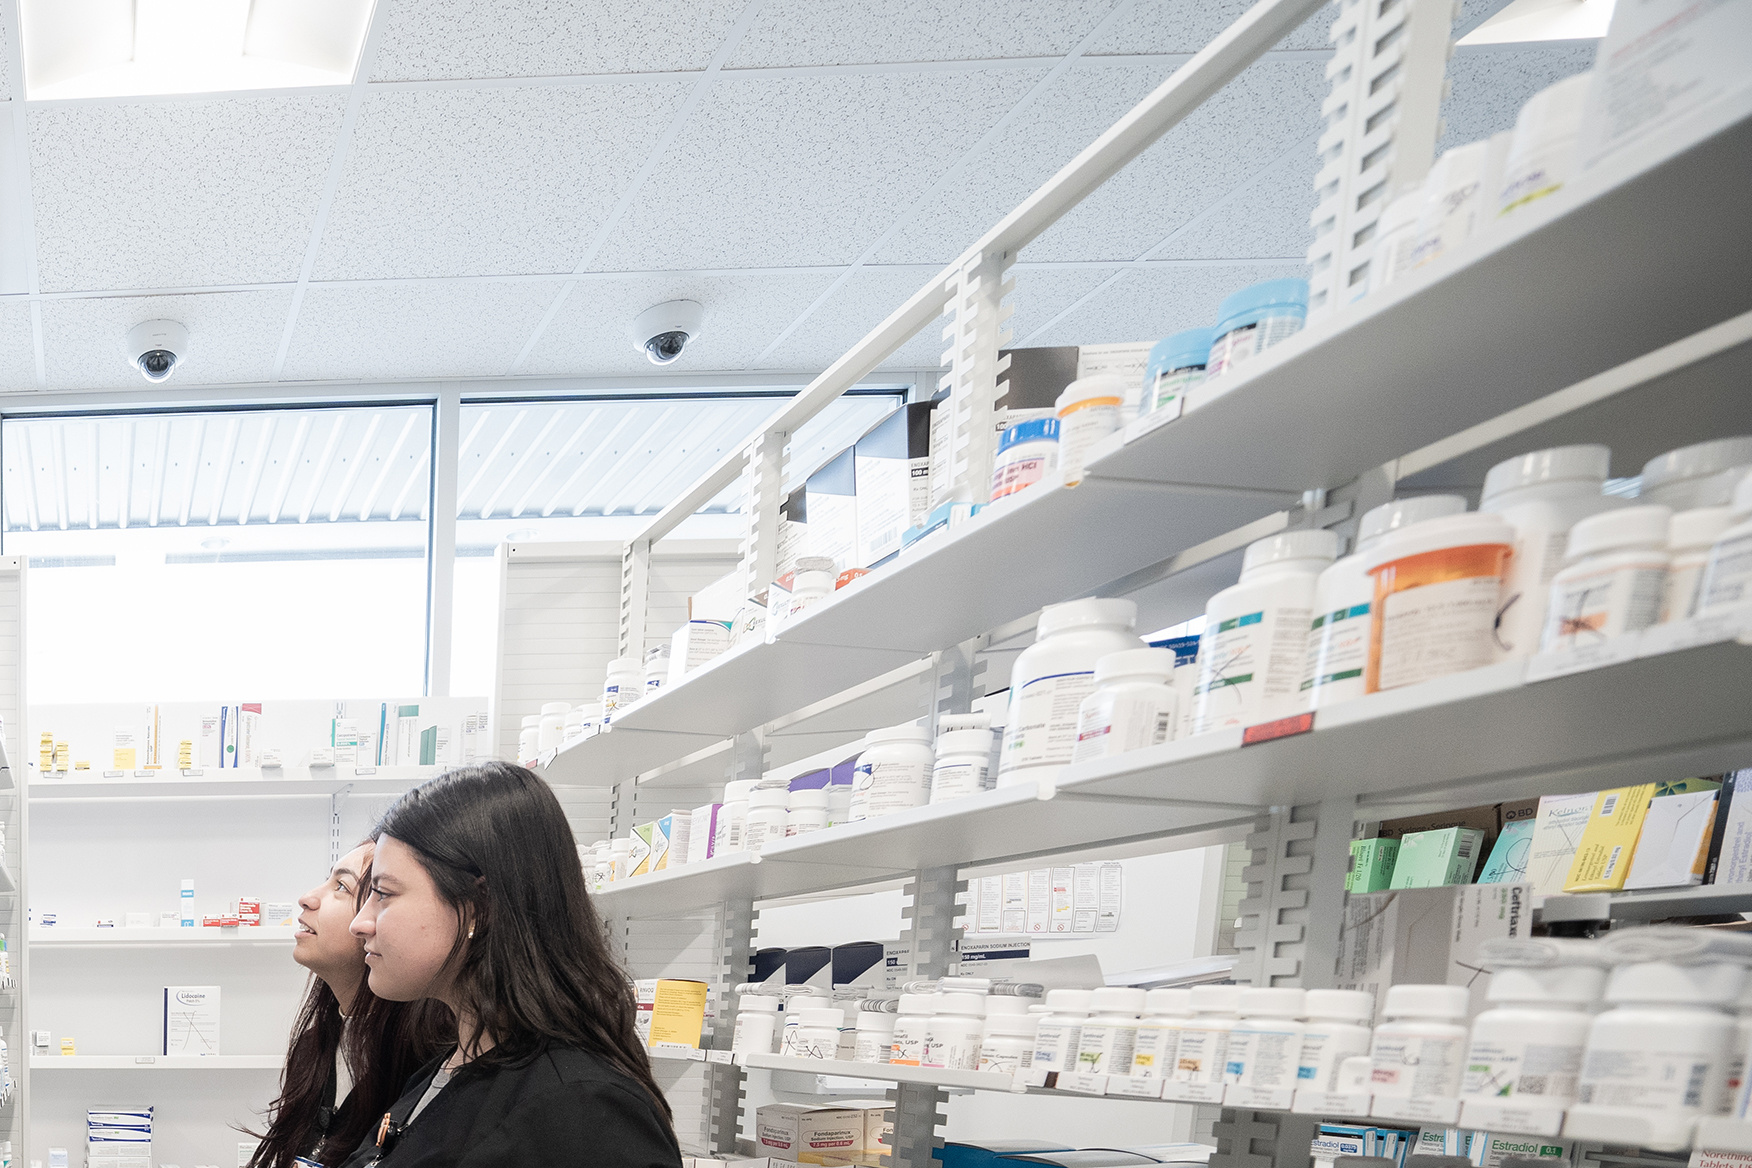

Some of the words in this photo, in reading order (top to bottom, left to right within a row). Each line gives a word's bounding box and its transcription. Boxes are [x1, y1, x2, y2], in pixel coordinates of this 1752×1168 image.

[1518, 808, 1534, 817] BD
[960, 943, 989, 951] ENOXAPARIN
[1492, 1139, 1539, 1153] Estradiol
[1545, 1146, 1557, 1154] 0.1
